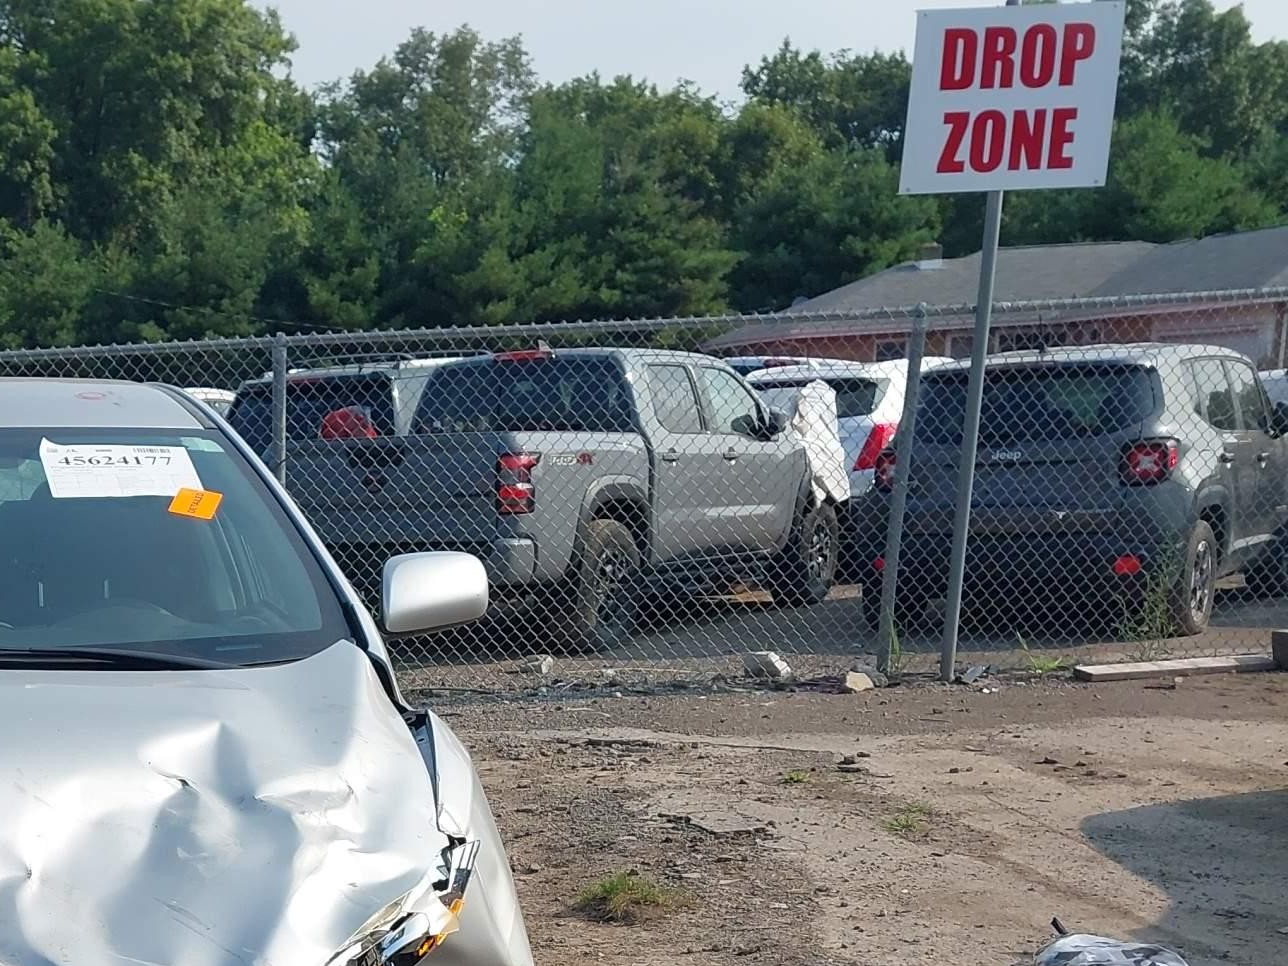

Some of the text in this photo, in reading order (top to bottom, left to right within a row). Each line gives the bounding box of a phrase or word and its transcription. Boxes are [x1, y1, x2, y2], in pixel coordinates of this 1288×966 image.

[939, 22, 1096, 90] DROP
[936, 107, 1078, 174] ZONE
[57, 456, 172, 466] 45624177
[992, 450, 1021, 461] Jeep
